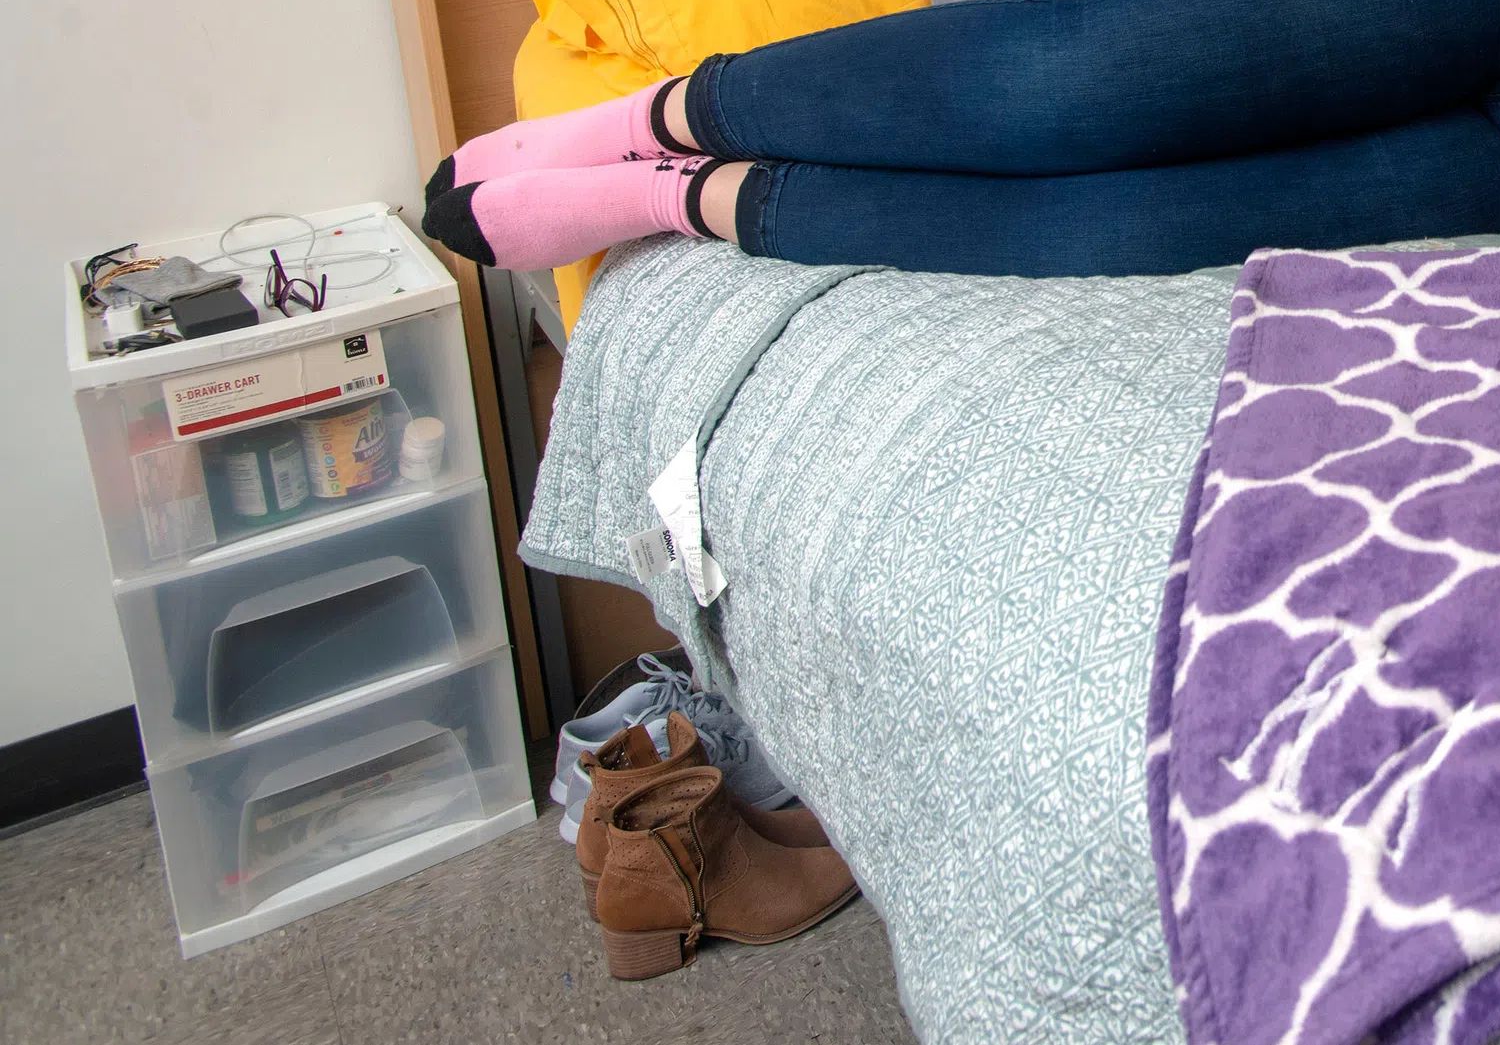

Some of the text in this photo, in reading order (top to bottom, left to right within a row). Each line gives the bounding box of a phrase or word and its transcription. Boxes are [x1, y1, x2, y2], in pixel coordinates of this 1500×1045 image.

[175, 382, 232, 403] 3-DRAWER
[234, 374, 261, 389] CART
[662, 529, 677, 563] SONOMA
